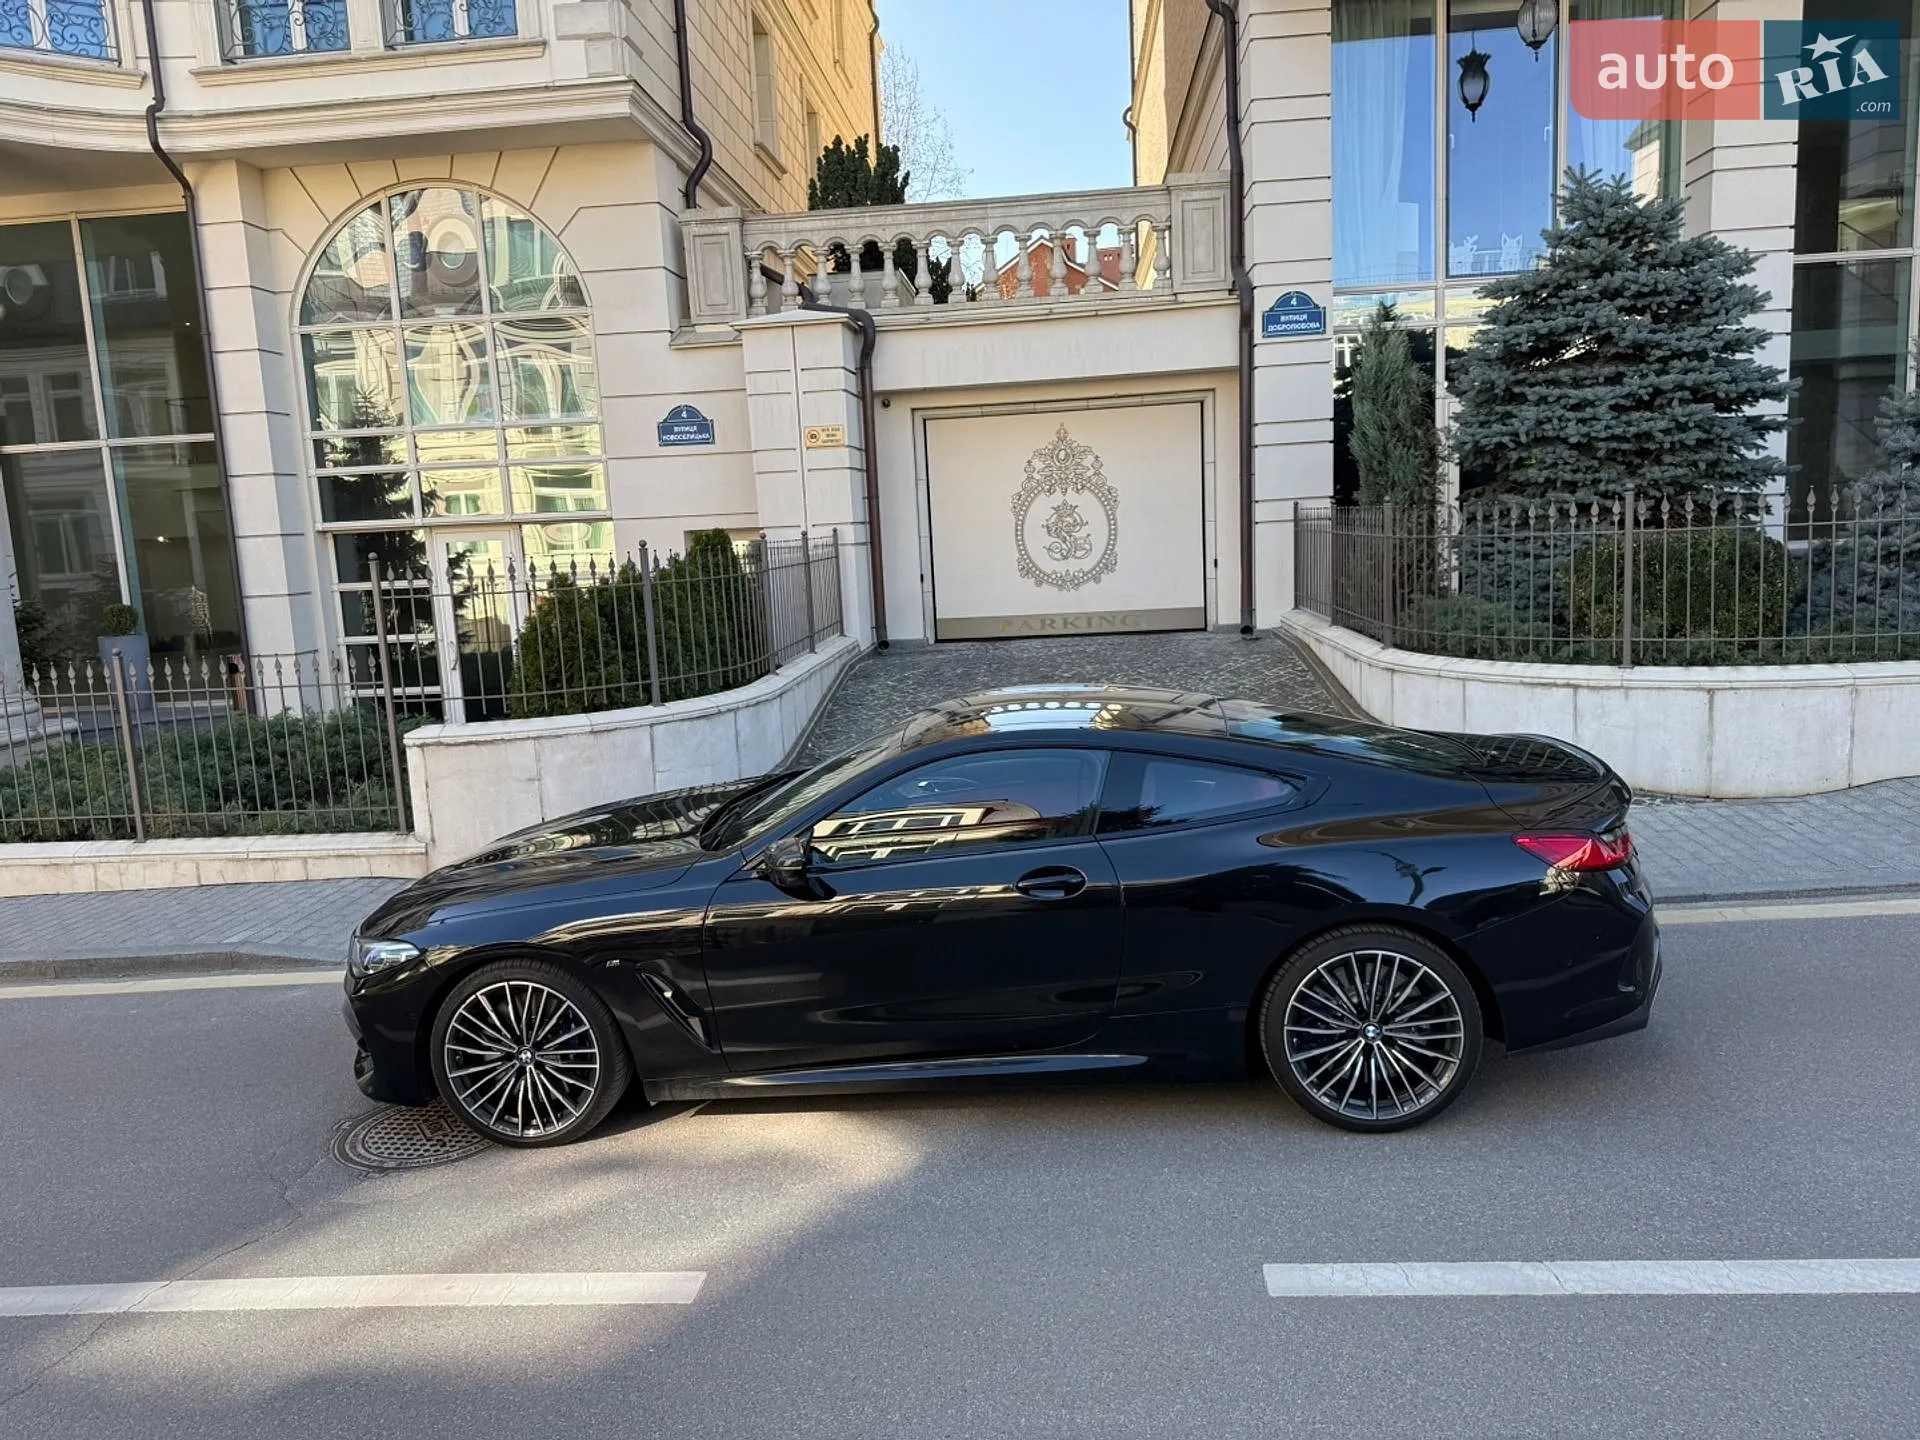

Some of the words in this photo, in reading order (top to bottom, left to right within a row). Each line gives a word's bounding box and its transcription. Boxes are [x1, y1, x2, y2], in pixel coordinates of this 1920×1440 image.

[1280, 314, 1308, 322] ВУЛИЦЯ
[1267, 322, 1321, 332] ДОБРОЛЮБОВА
[999, 614, 1141, 632] PARKING
